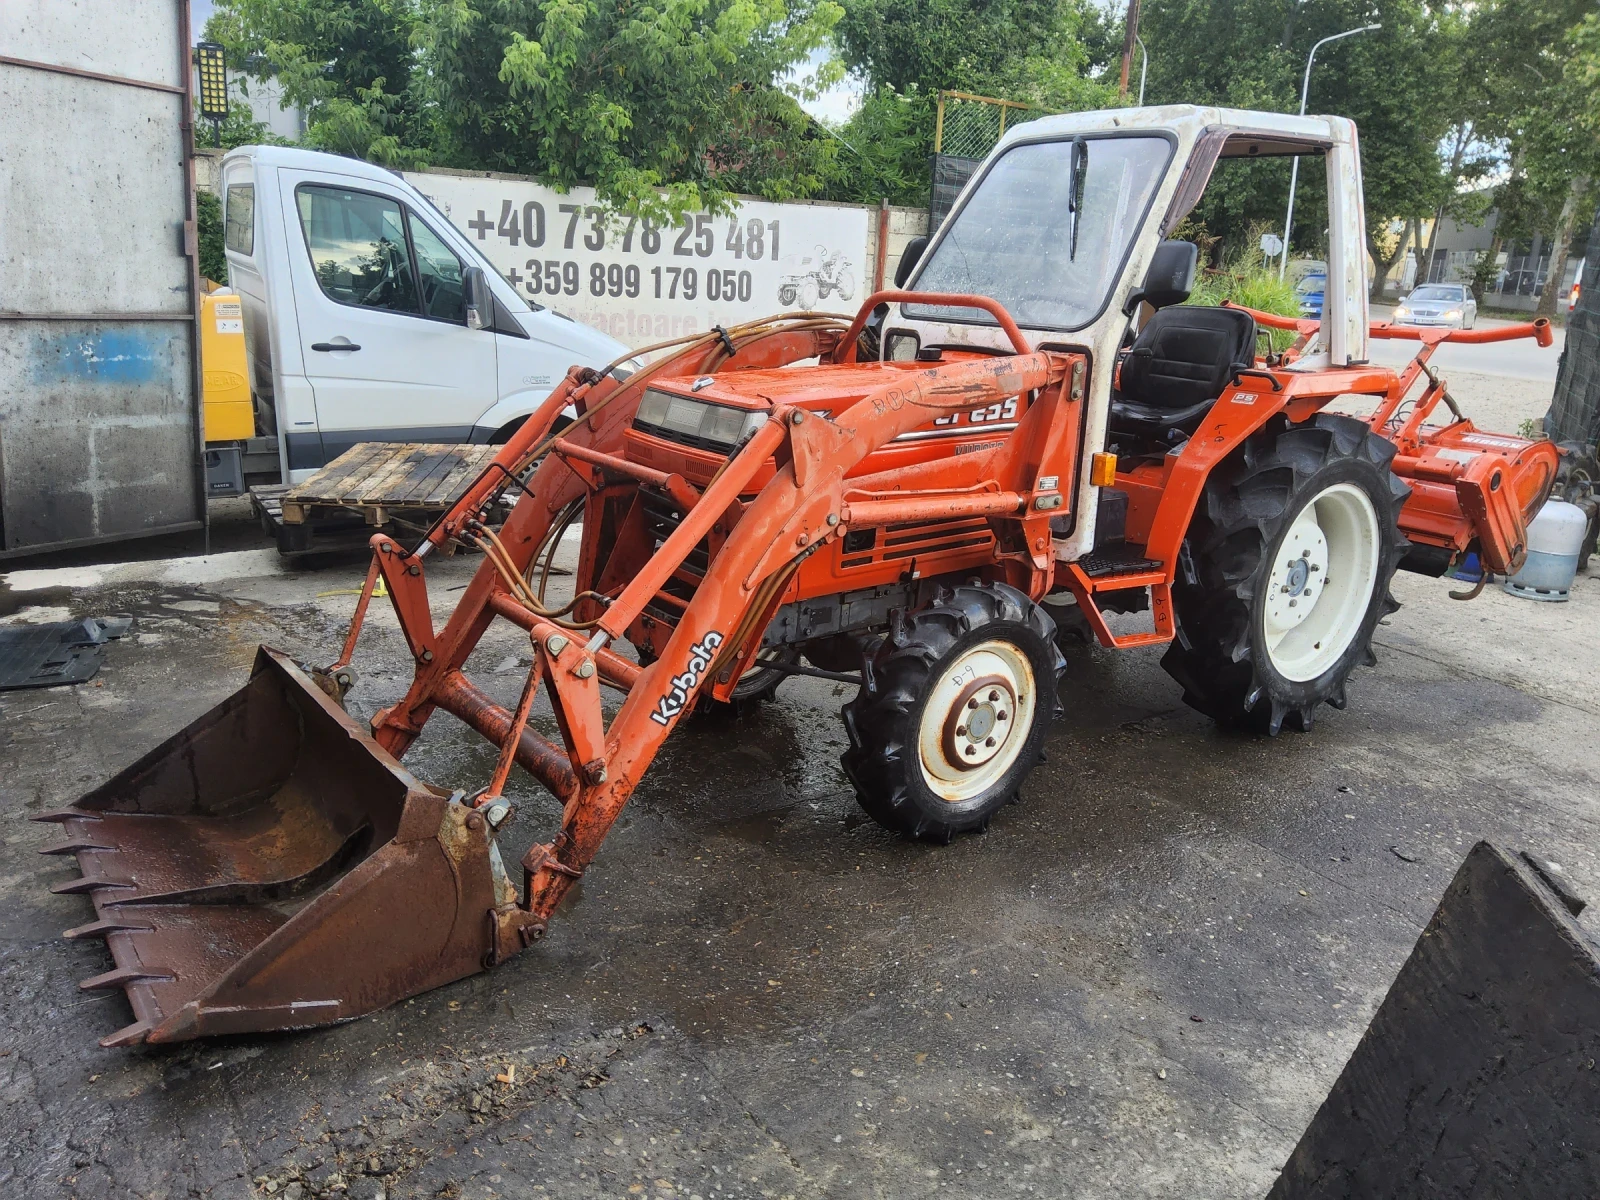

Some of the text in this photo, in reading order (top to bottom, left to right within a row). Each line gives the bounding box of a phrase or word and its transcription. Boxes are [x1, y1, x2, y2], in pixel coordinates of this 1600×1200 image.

[468, 199, 780, 261] +40 73 78 25 481
[505, 259, 752, 302] +359 899 179 050
[650, 630, 724, 727] Kubota
